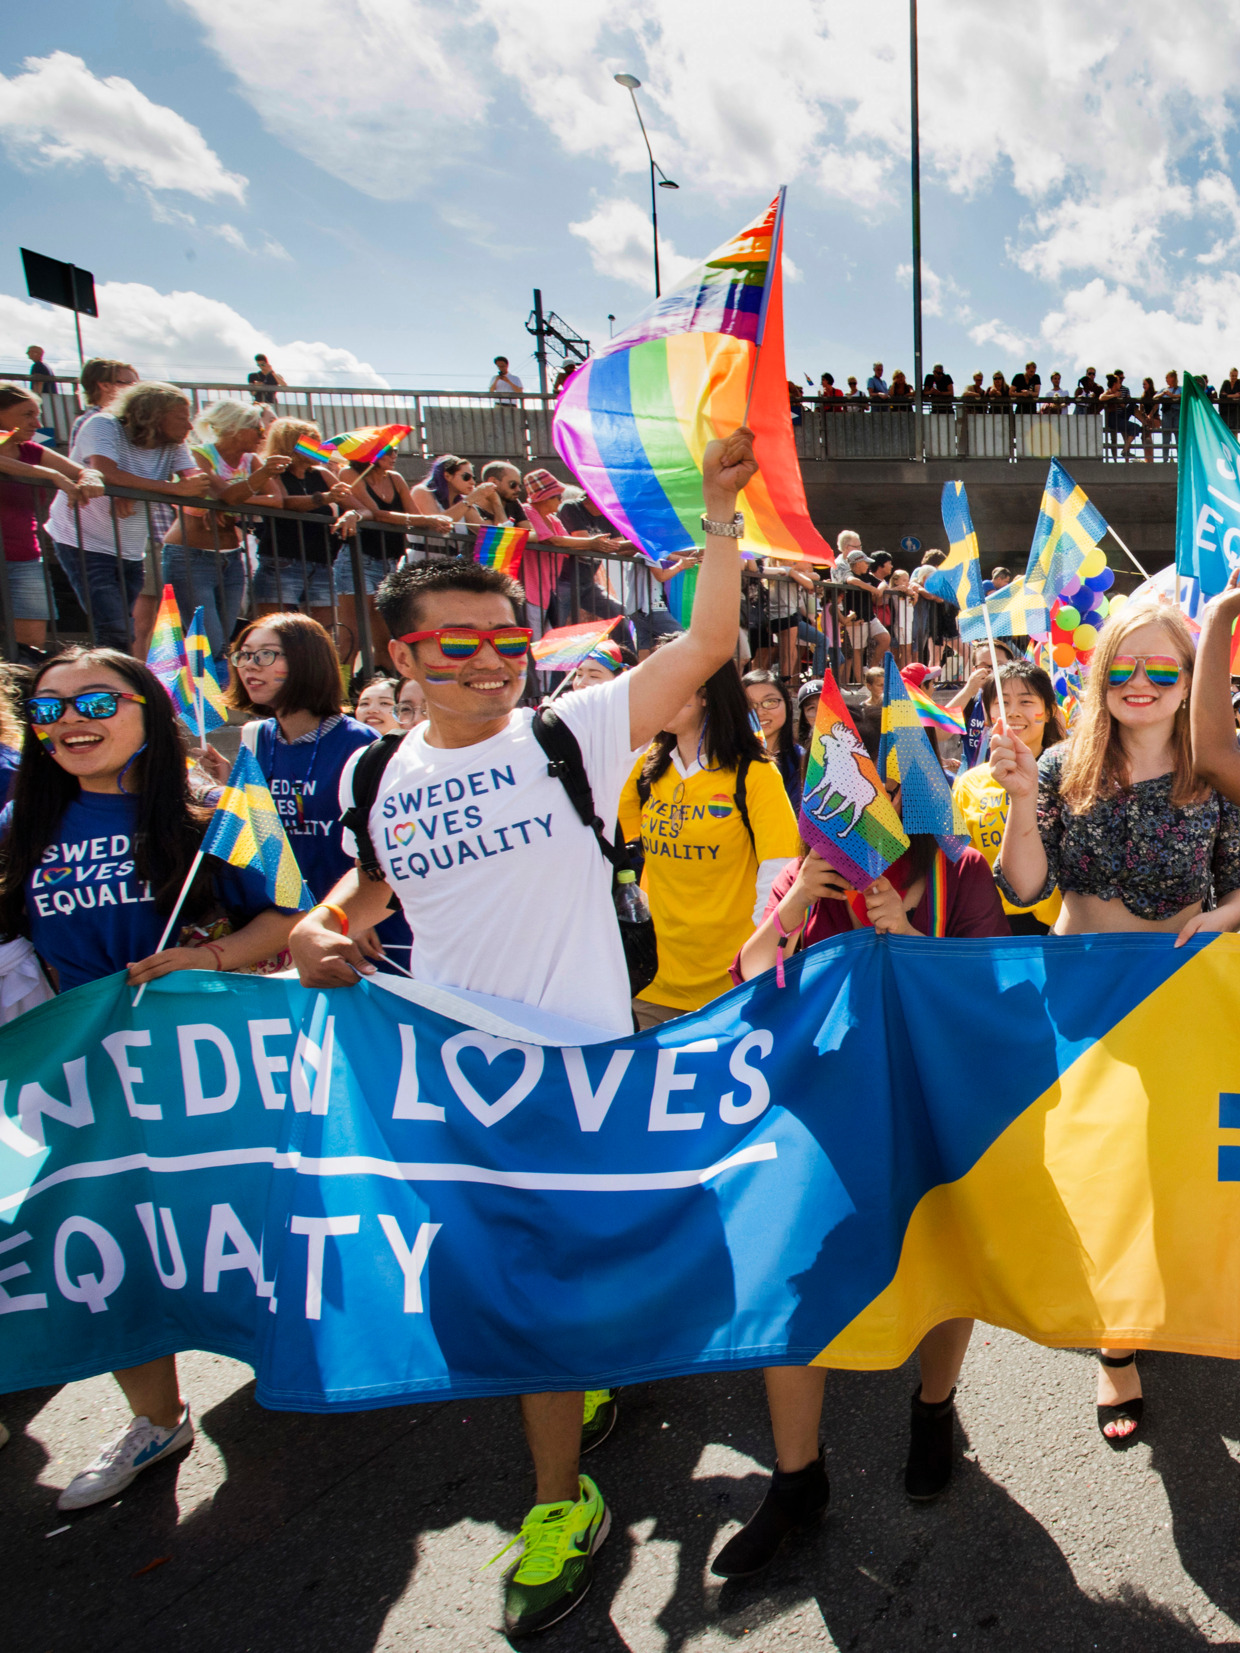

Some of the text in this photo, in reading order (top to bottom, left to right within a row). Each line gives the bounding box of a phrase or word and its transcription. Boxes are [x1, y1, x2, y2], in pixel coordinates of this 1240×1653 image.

[381, 764, 517, 820] SWEDEN
[646, 799, 706, 821] WEDEN
[41, 834, 131, 864] SWED
[390, 813, 555, 882] EQUALITY
[642, 836, 720, 860] QUALITY
[33, 880, 156, 918] EQUALI
[0, 1015, 335, 1158] WEDEN
[0, 1201, 444, 1321] EQUATY
